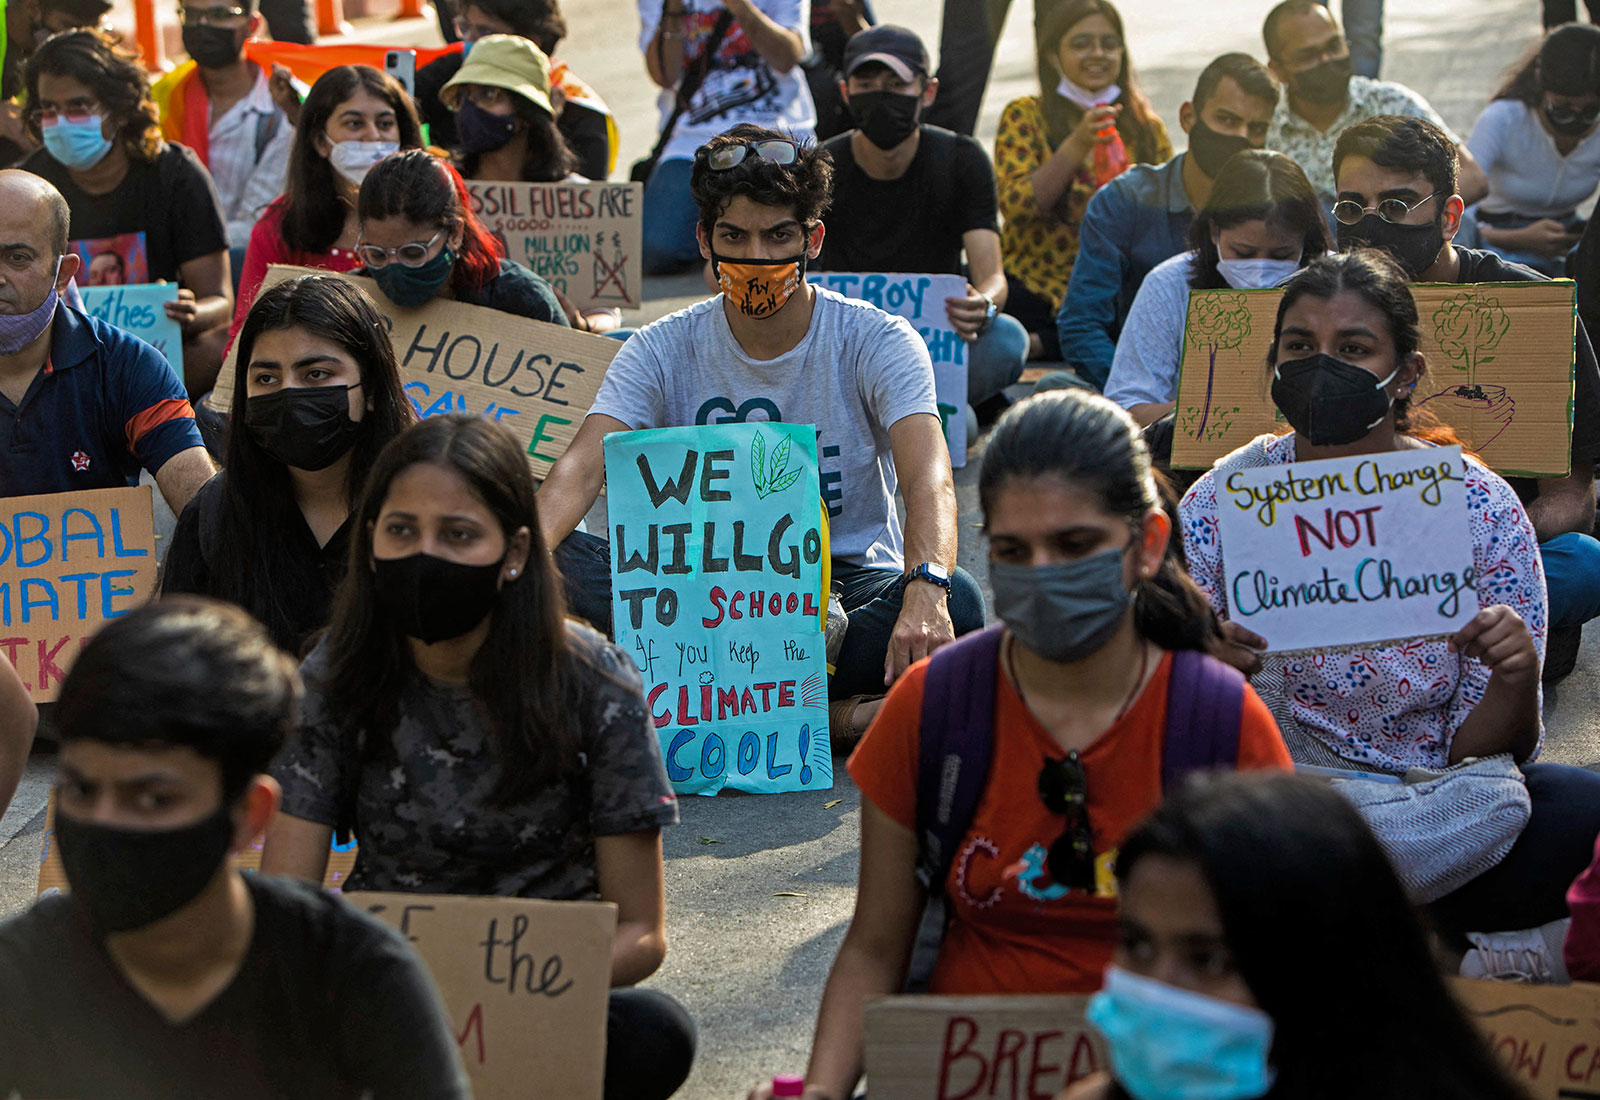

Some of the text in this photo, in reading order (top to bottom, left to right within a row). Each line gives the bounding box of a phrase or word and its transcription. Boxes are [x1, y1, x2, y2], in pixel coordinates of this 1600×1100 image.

[530, 187, 594, 219] FUELS
[598, 187, 634, 217] ARE
[525, 233, 590, 254] MILLION
[525, 252, 579, 276] YEARS
[807, 274, 931, 319] TROY
[402, 324, 585, 406] HOUSE
[636, 449, 735, 509] WE
[1226, 461, 1465, 527] System Change
[1293, 506, 1383, 557] NOT
[619, 586, 818, 630] TO SCHOOL
[1233, 558, 1475, 618] Climate Change
[675, 642, 708, 677] you
[784, 640, 810, 661] the
[667, 723, 812, 785] COOL!
[479, 913, 574, 997] the
